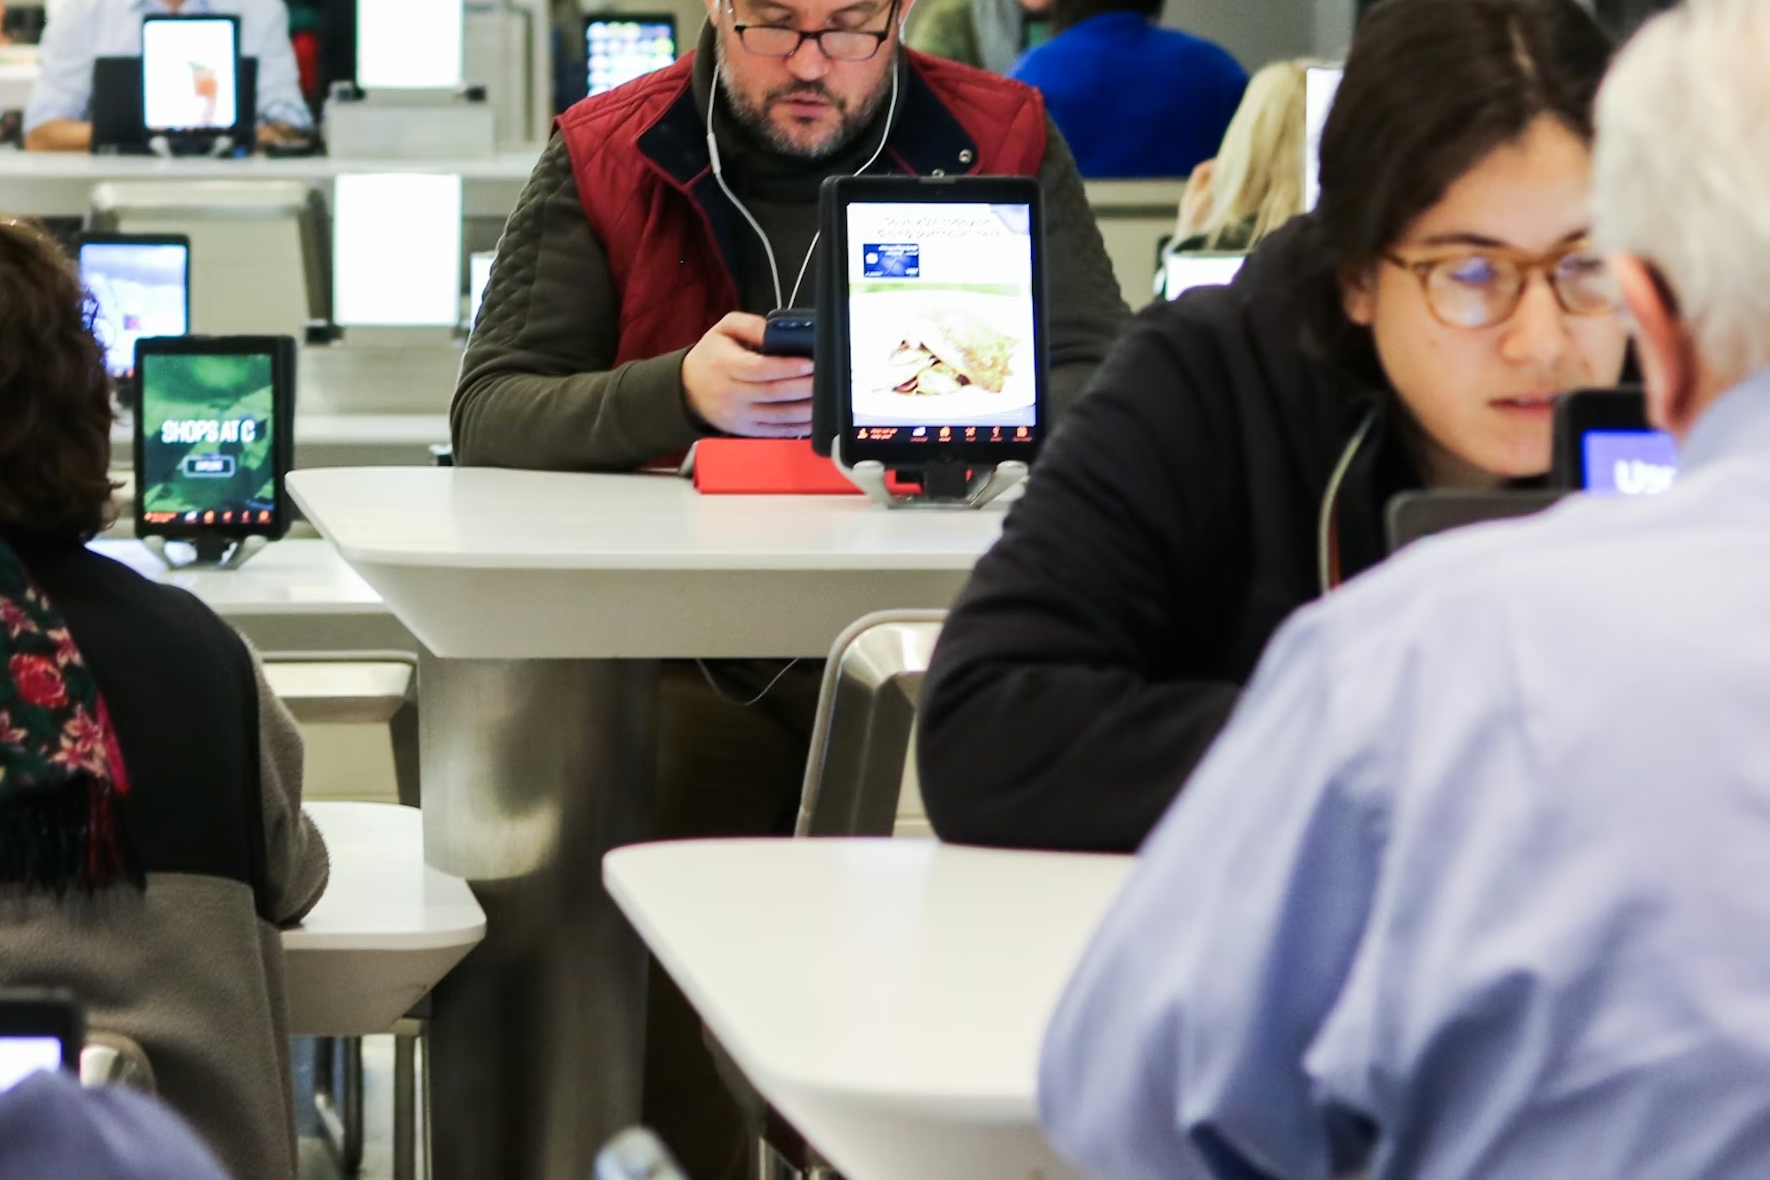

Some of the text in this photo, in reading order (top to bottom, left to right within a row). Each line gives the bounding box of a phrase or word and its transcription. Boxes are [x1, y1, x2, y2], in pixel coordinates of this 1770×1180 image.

[161, 419, 255, 443] SHOPS AT C
